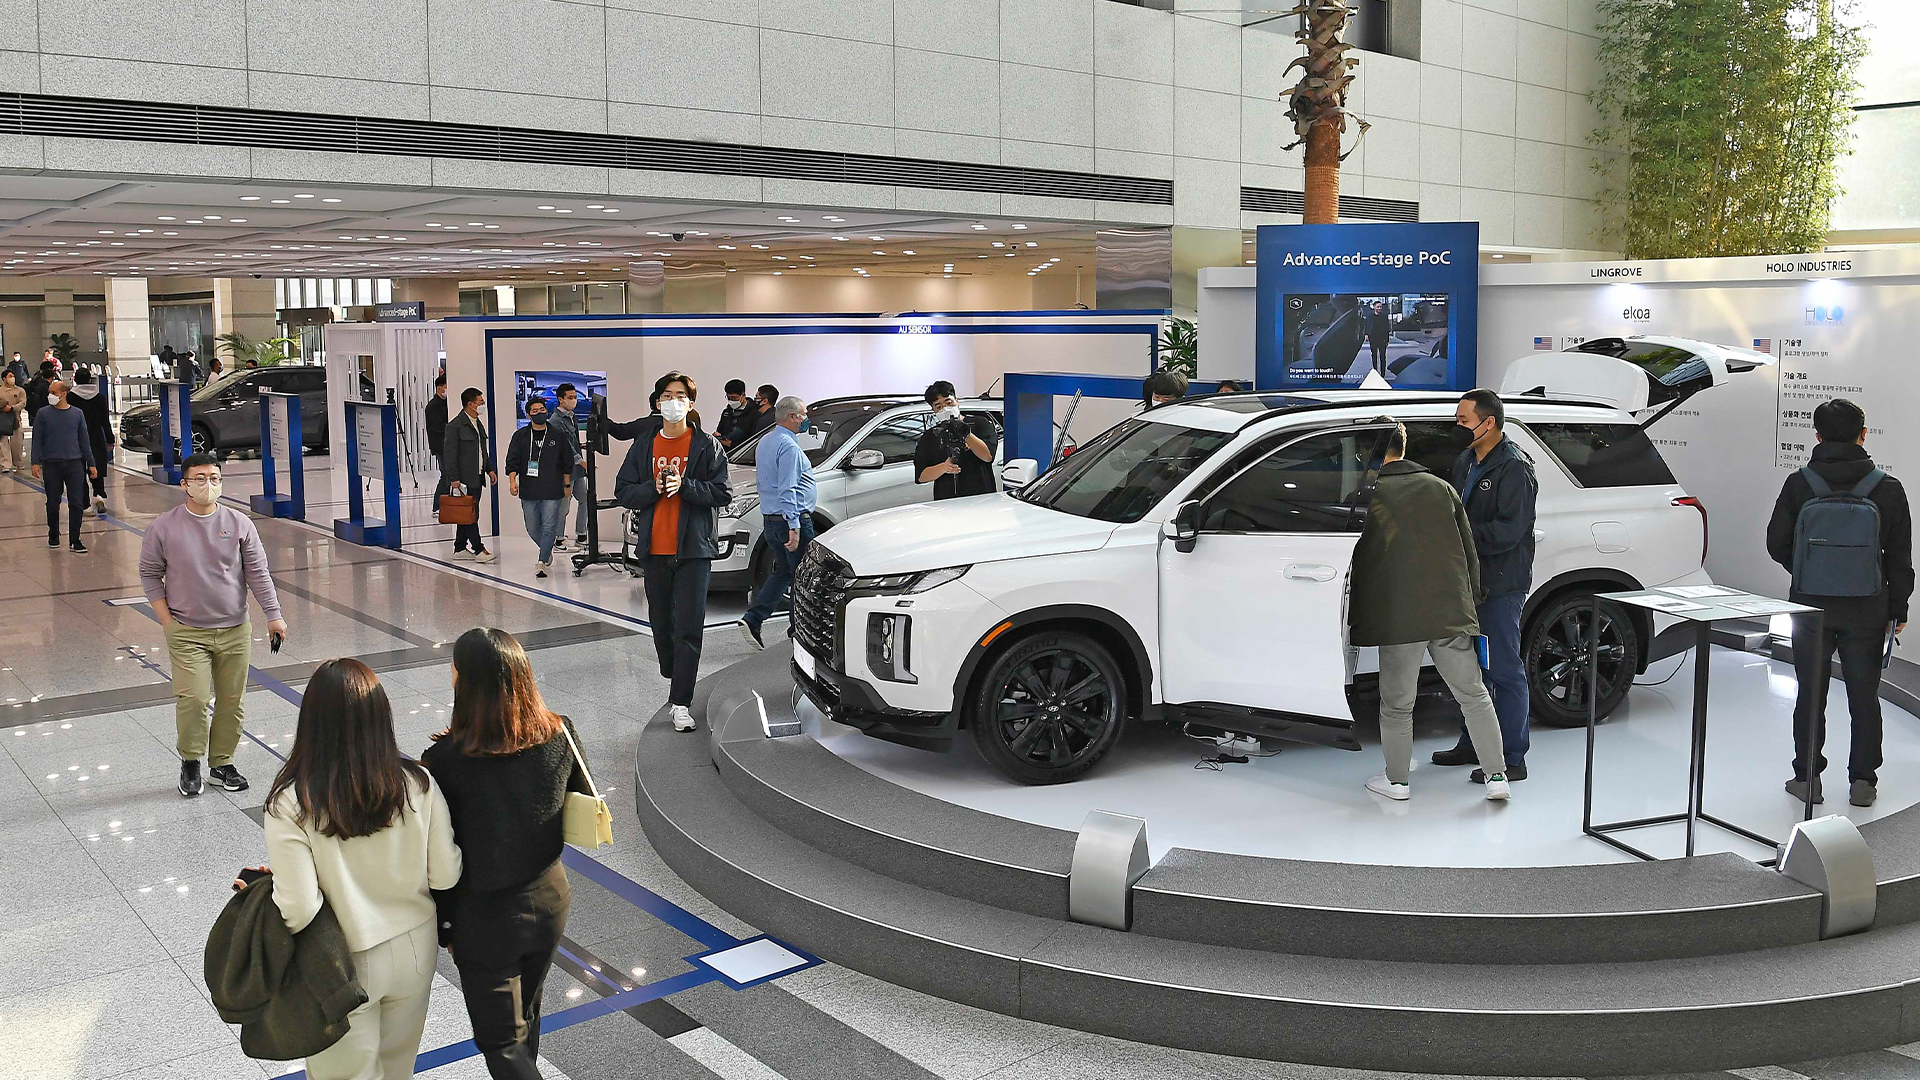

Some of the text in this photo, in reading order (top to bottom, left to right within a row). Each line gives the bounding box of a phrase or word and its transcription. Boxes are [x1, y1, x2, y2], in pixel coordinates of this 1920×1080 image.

[1283, 251, 1451, 268] Advanced-stage PoC
[1766, 260, 1852, 273] HOLO INDUSTRIES
[1591, 267, 1642, 278] LINGROVE
[1623, 305, 1650, 320] ekoa
[1805, 306, 1844, 321] HOLO
[908, 325, 932, 334] SENSOR
[1785, 339, 1802, 348] 기술명
[1784, 372, 1794, 380] 기술
[1782, 410, 1812, 419] 상품화 컨셉
[1781, 442, 1792, 450] 협업
